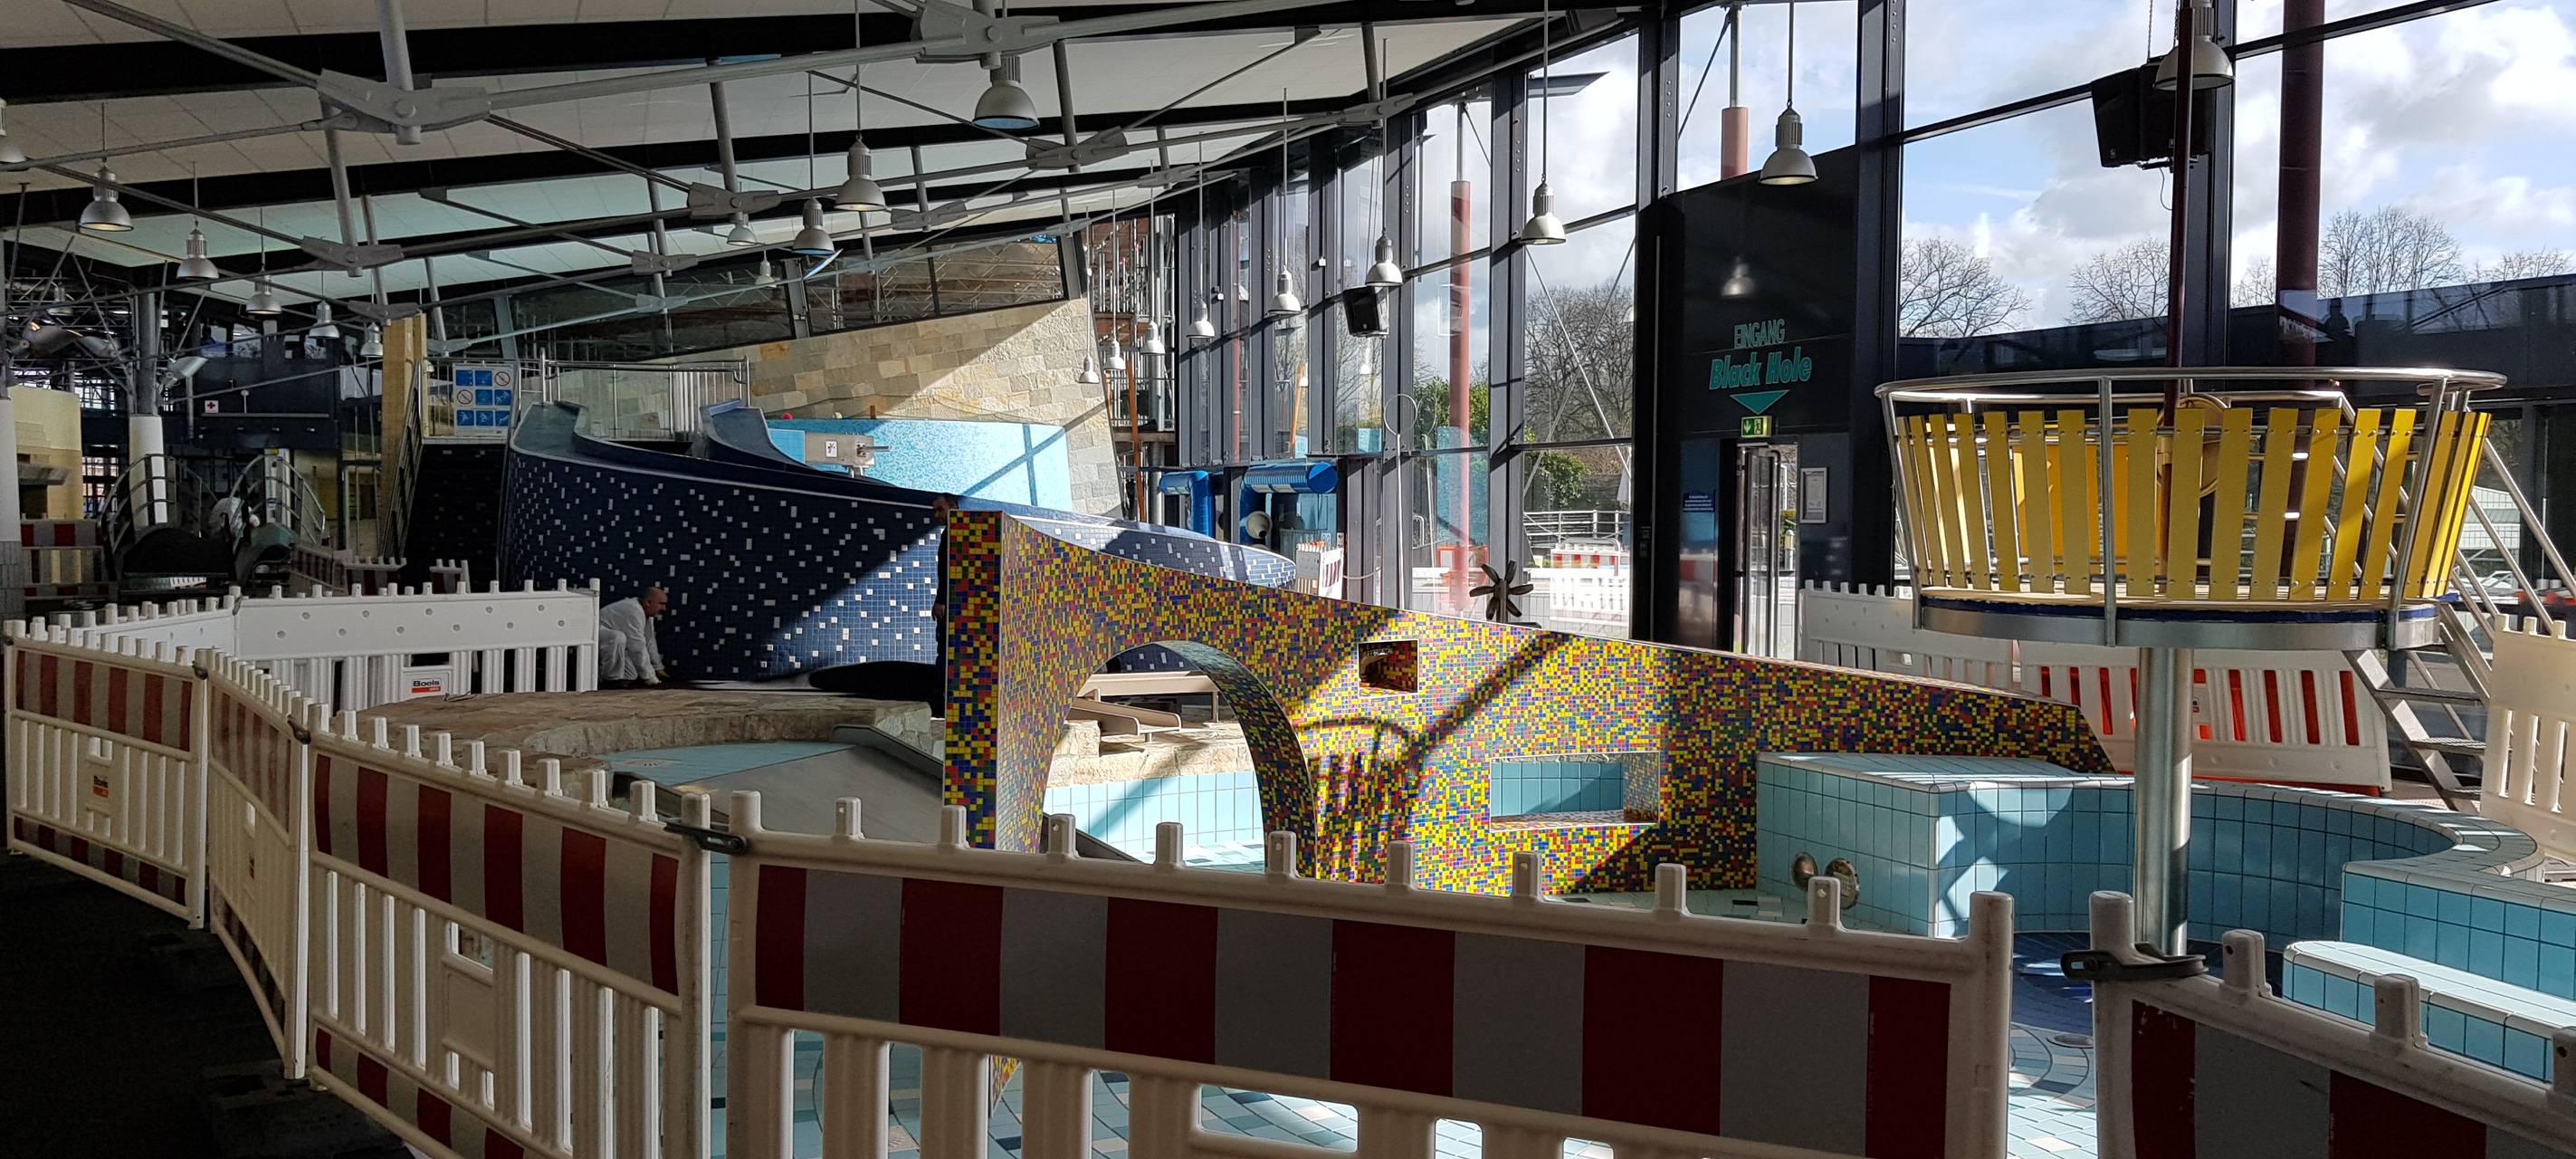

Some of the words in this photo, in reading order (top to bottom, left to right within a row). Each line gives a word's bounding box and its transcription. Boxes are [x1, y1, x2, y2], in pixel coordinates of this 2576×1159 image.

[1734, 319, 1786, 349] EINGANG
[1709, 352, 1762, 390] Black
[1766, 347, 1812, 384] Hole
